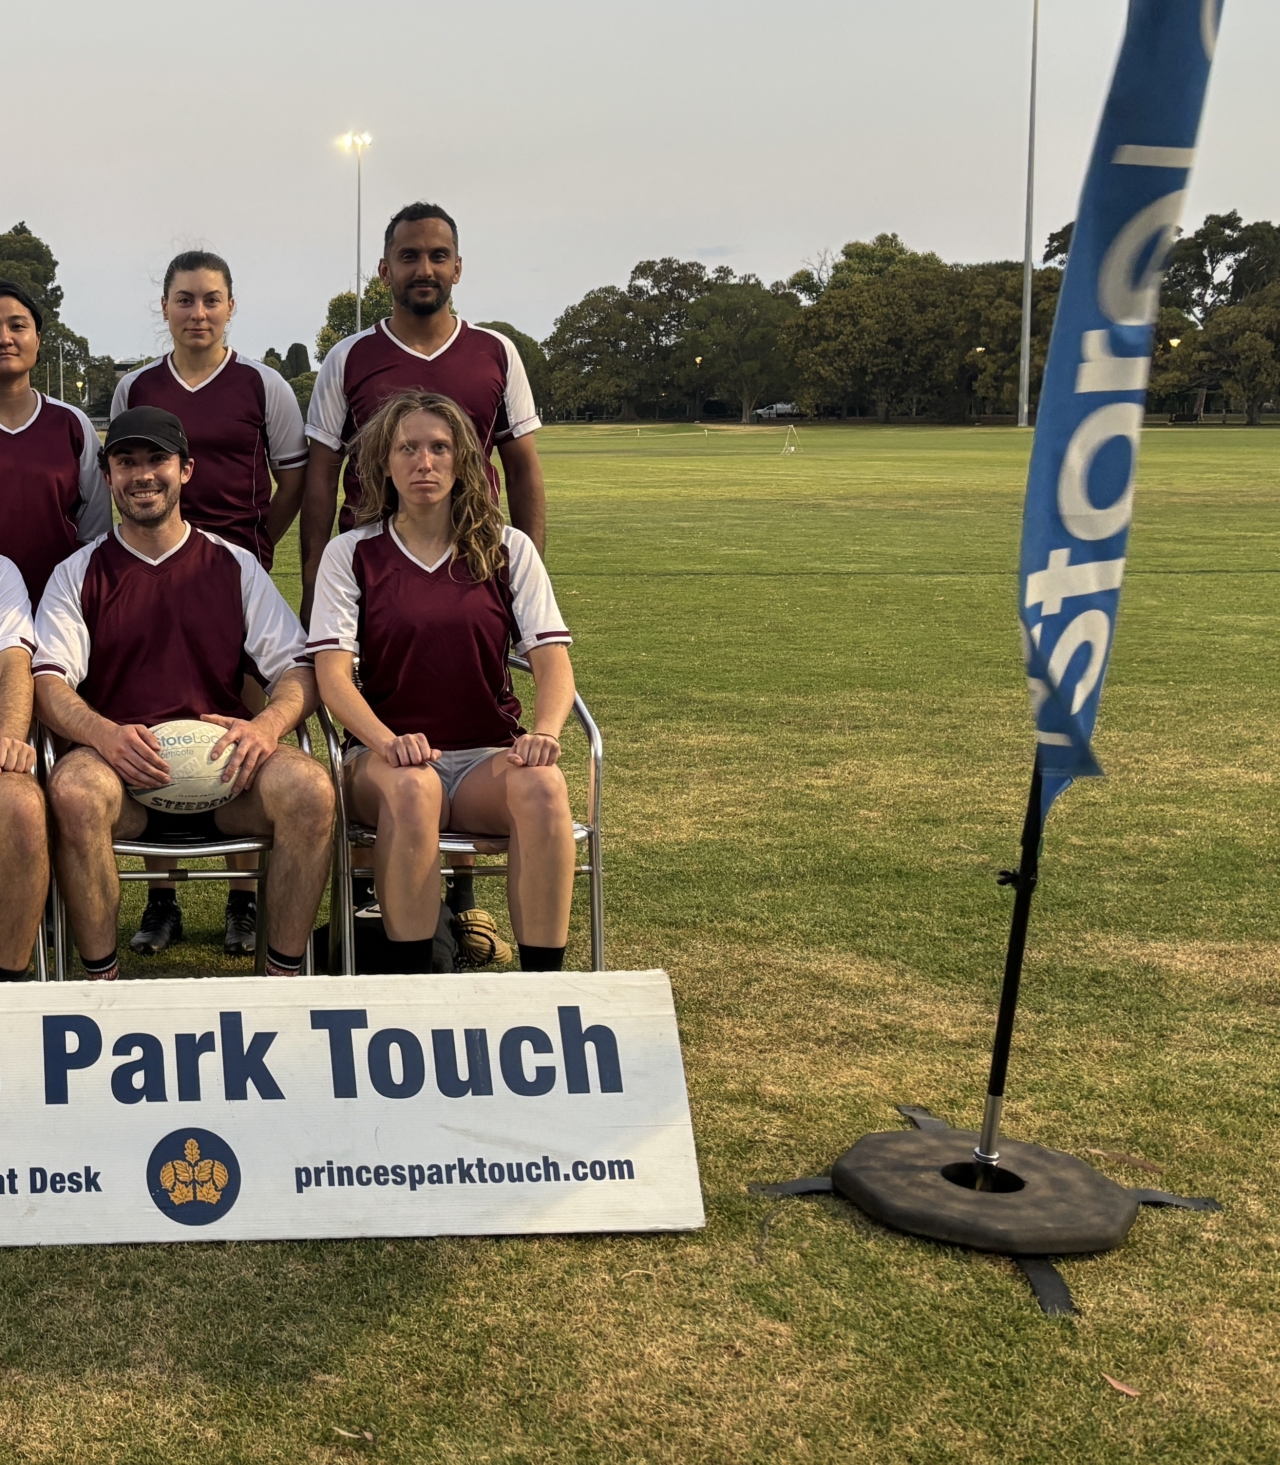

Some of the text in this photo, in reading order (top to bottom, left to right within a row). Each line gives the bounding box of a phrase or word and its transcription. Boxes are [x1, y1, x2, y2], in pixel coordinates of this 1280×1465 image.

[150, 793, 234, 811] STEEDEN
[42, 1011, 286, 1105] Park
[309, 1005, 624, 1100] Touch
[29, 1165, 103, 1194] Desk
[294, 1155, 635, 1194] princesparktouch.com
